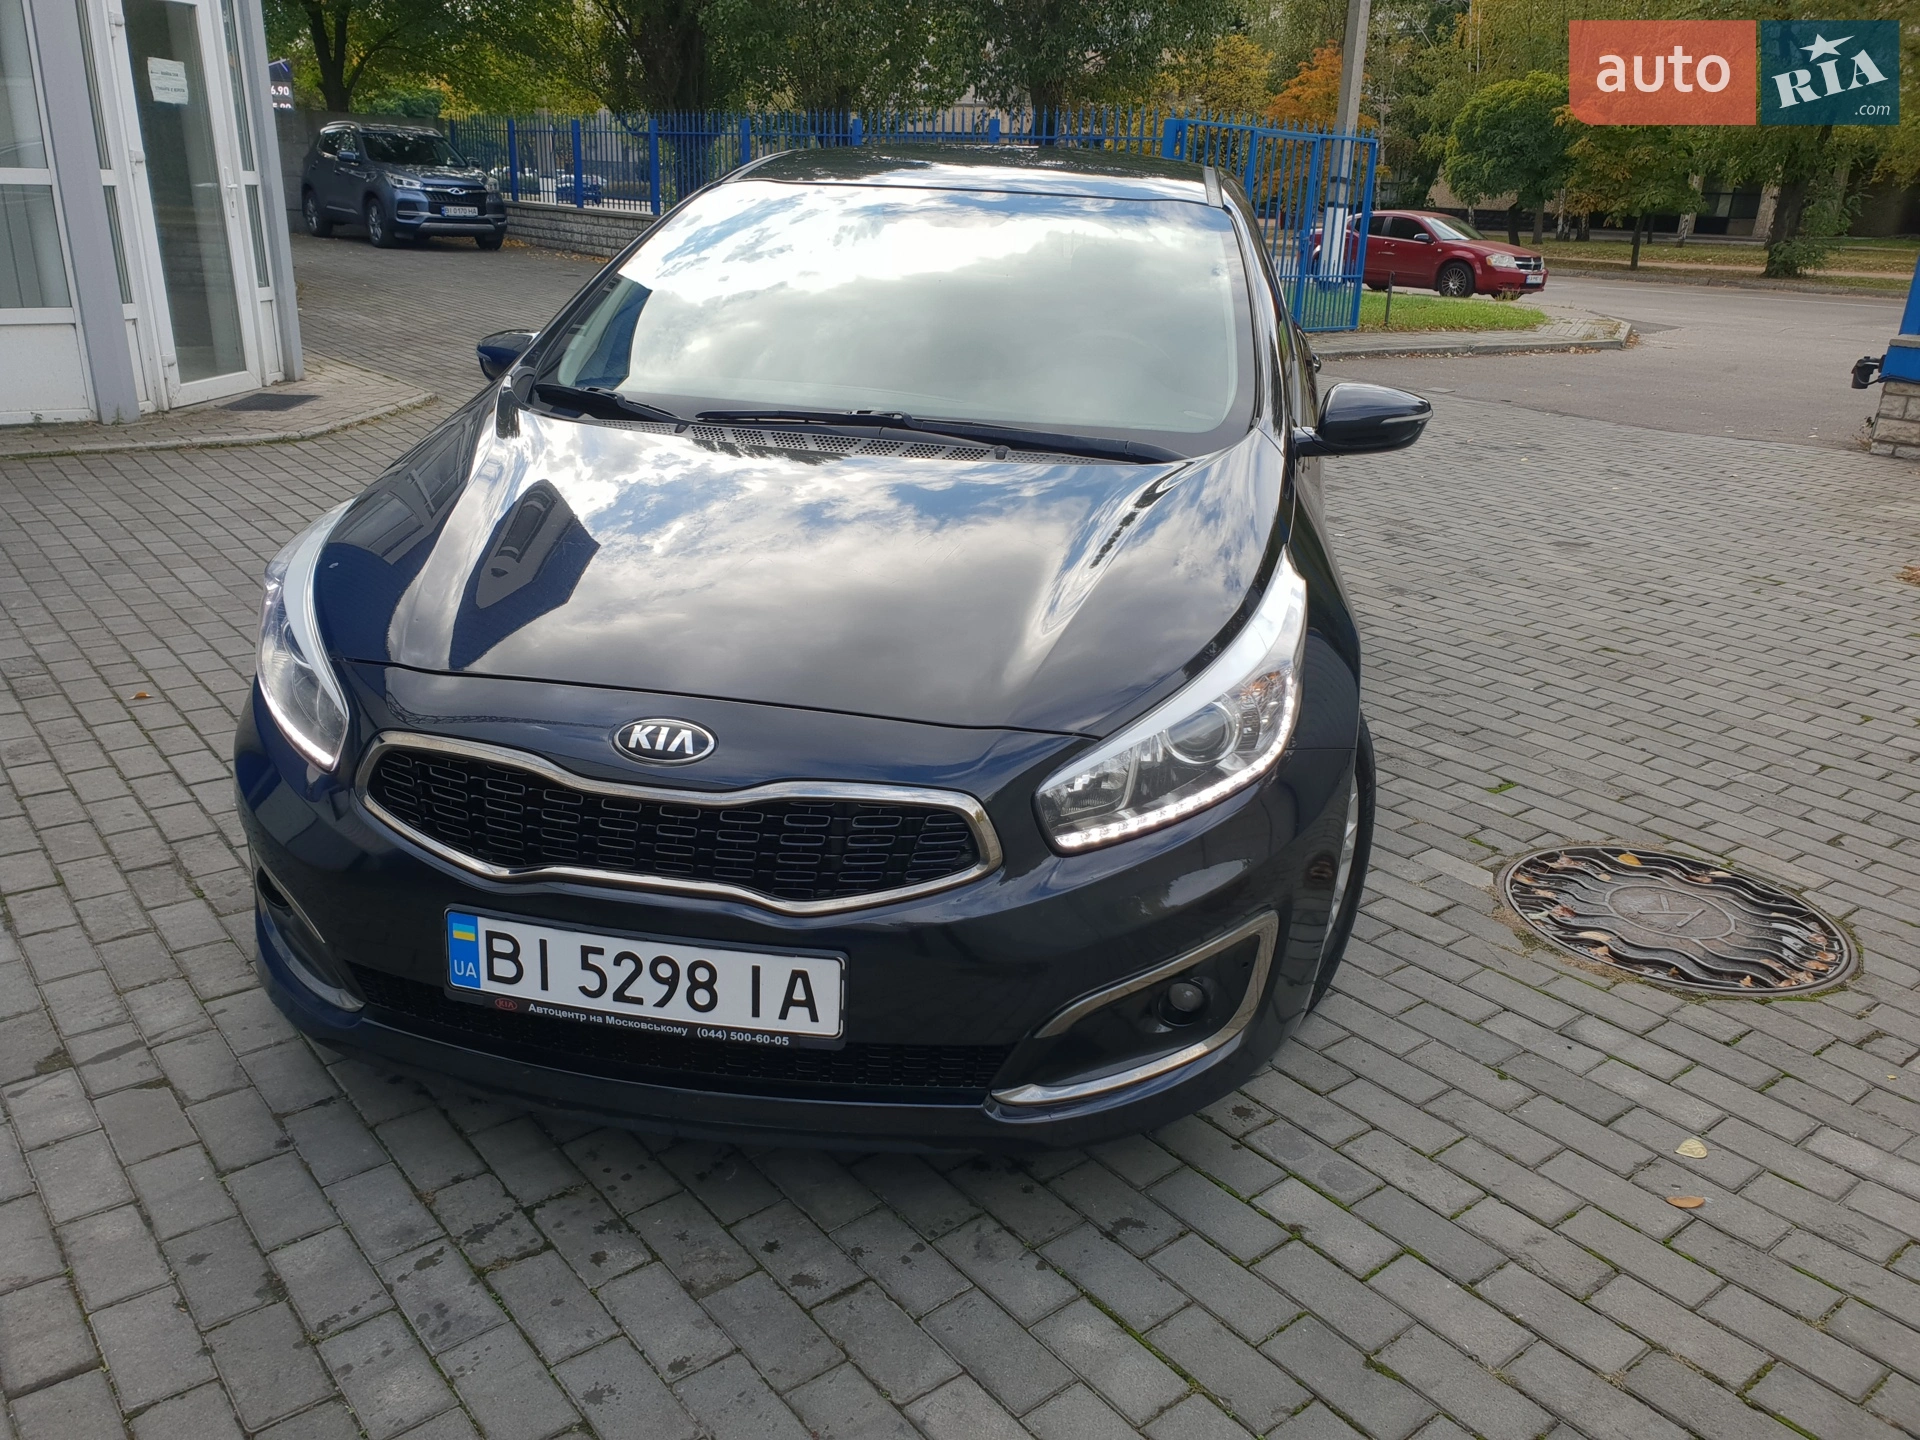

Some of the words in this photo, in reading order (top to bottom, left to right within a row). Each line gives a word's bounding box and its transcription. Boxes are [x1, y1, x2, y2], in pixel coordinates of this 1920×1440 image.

[628, 724, 694, 755] KIA
[454, 959, 477, 978] UA
[485, 929, 549, 991] BI
[578, 944, 718, 1013] 5298
[751, 965, 820, 1023] IA
[498, 999, 514, 1009] KIA
[528, 1003, 587, 1022] Автоцентр
[589, 1014, 603, 1023] на
[605, 1015, 688, 1036] Московському
[696, 1027, 727, 1041] (044)
[729, 1031, 789, 1046] 500-60-05
